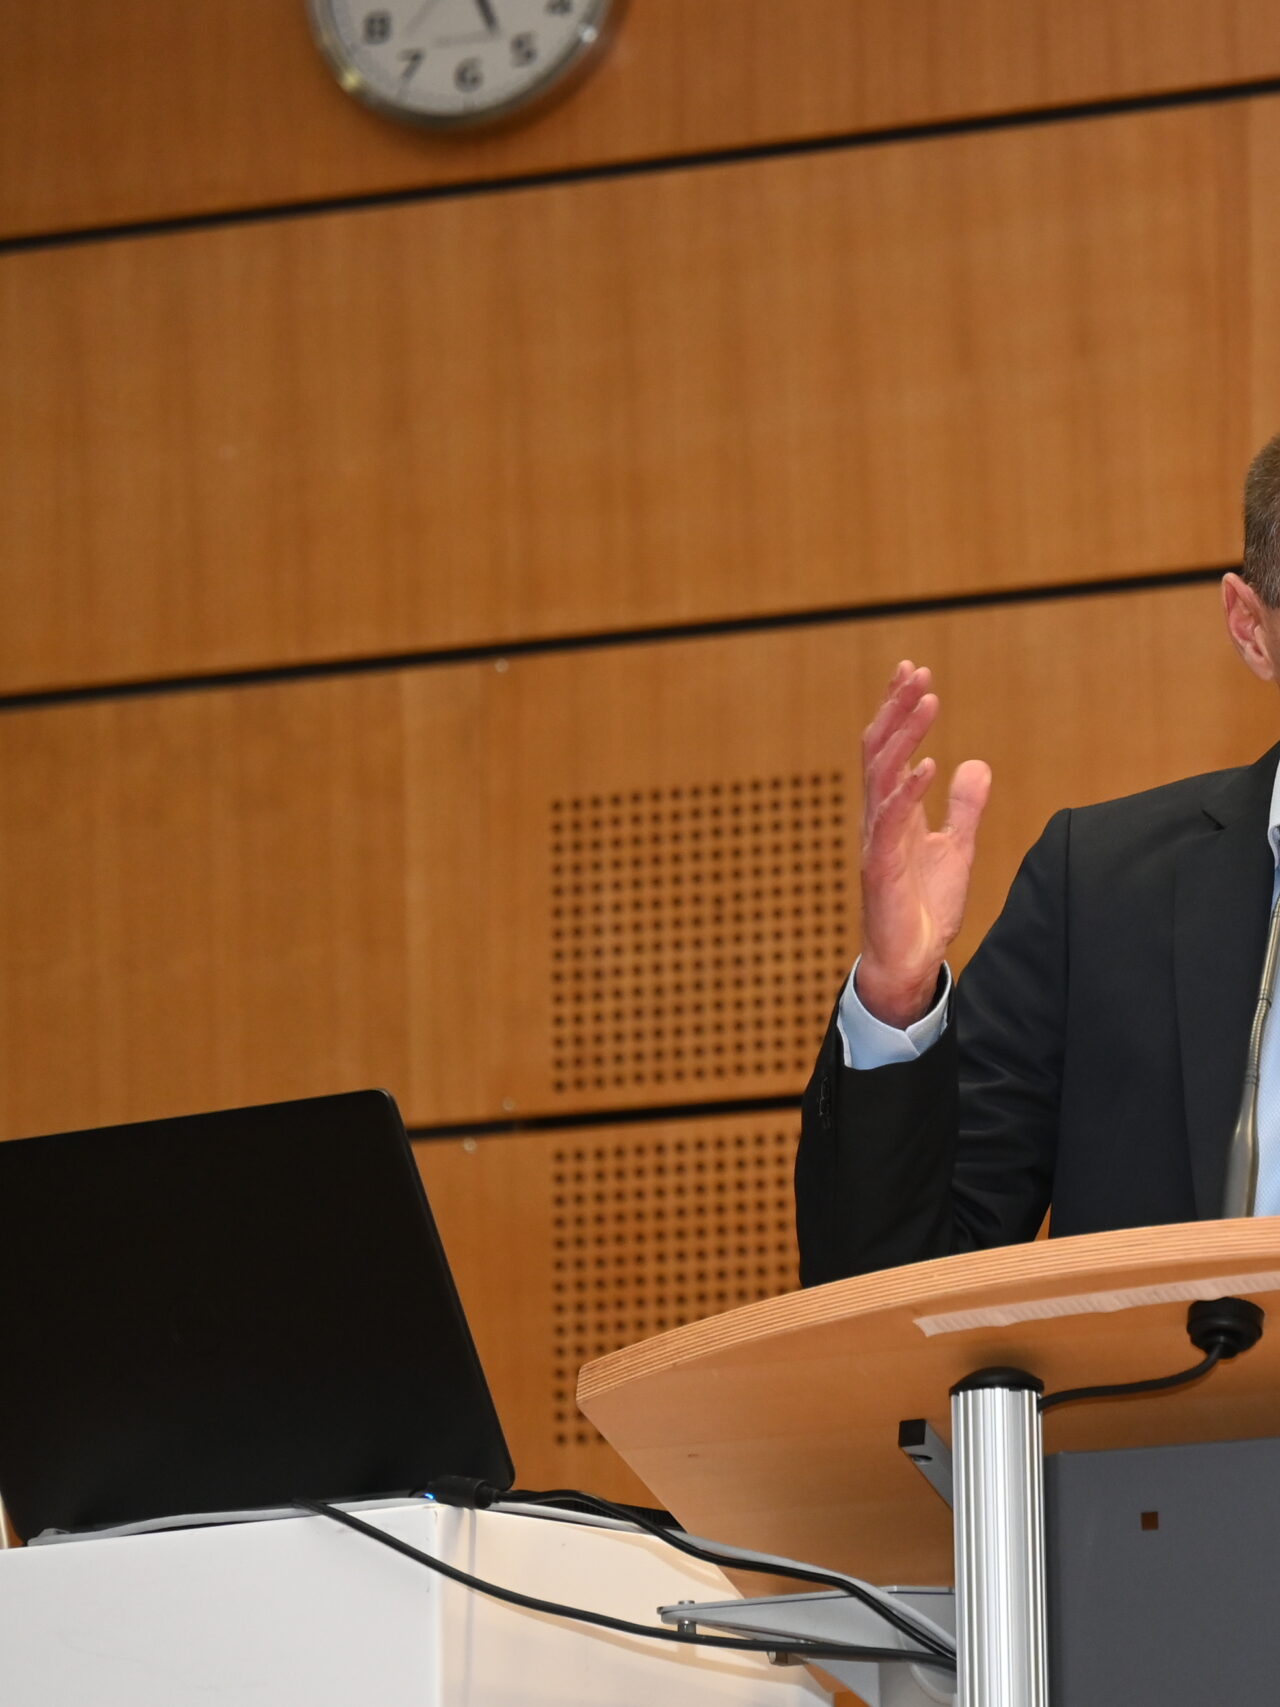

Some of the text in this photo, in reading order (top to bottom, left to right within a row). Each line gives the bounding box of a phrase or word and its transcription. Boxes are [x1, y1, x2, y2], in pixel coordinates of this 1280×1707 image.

[363, 9, 393, 45] 8
[398, 48, 426, 86] 7
[510, 31, 538, 69] 5
[453, 57, 484, 93] 6
